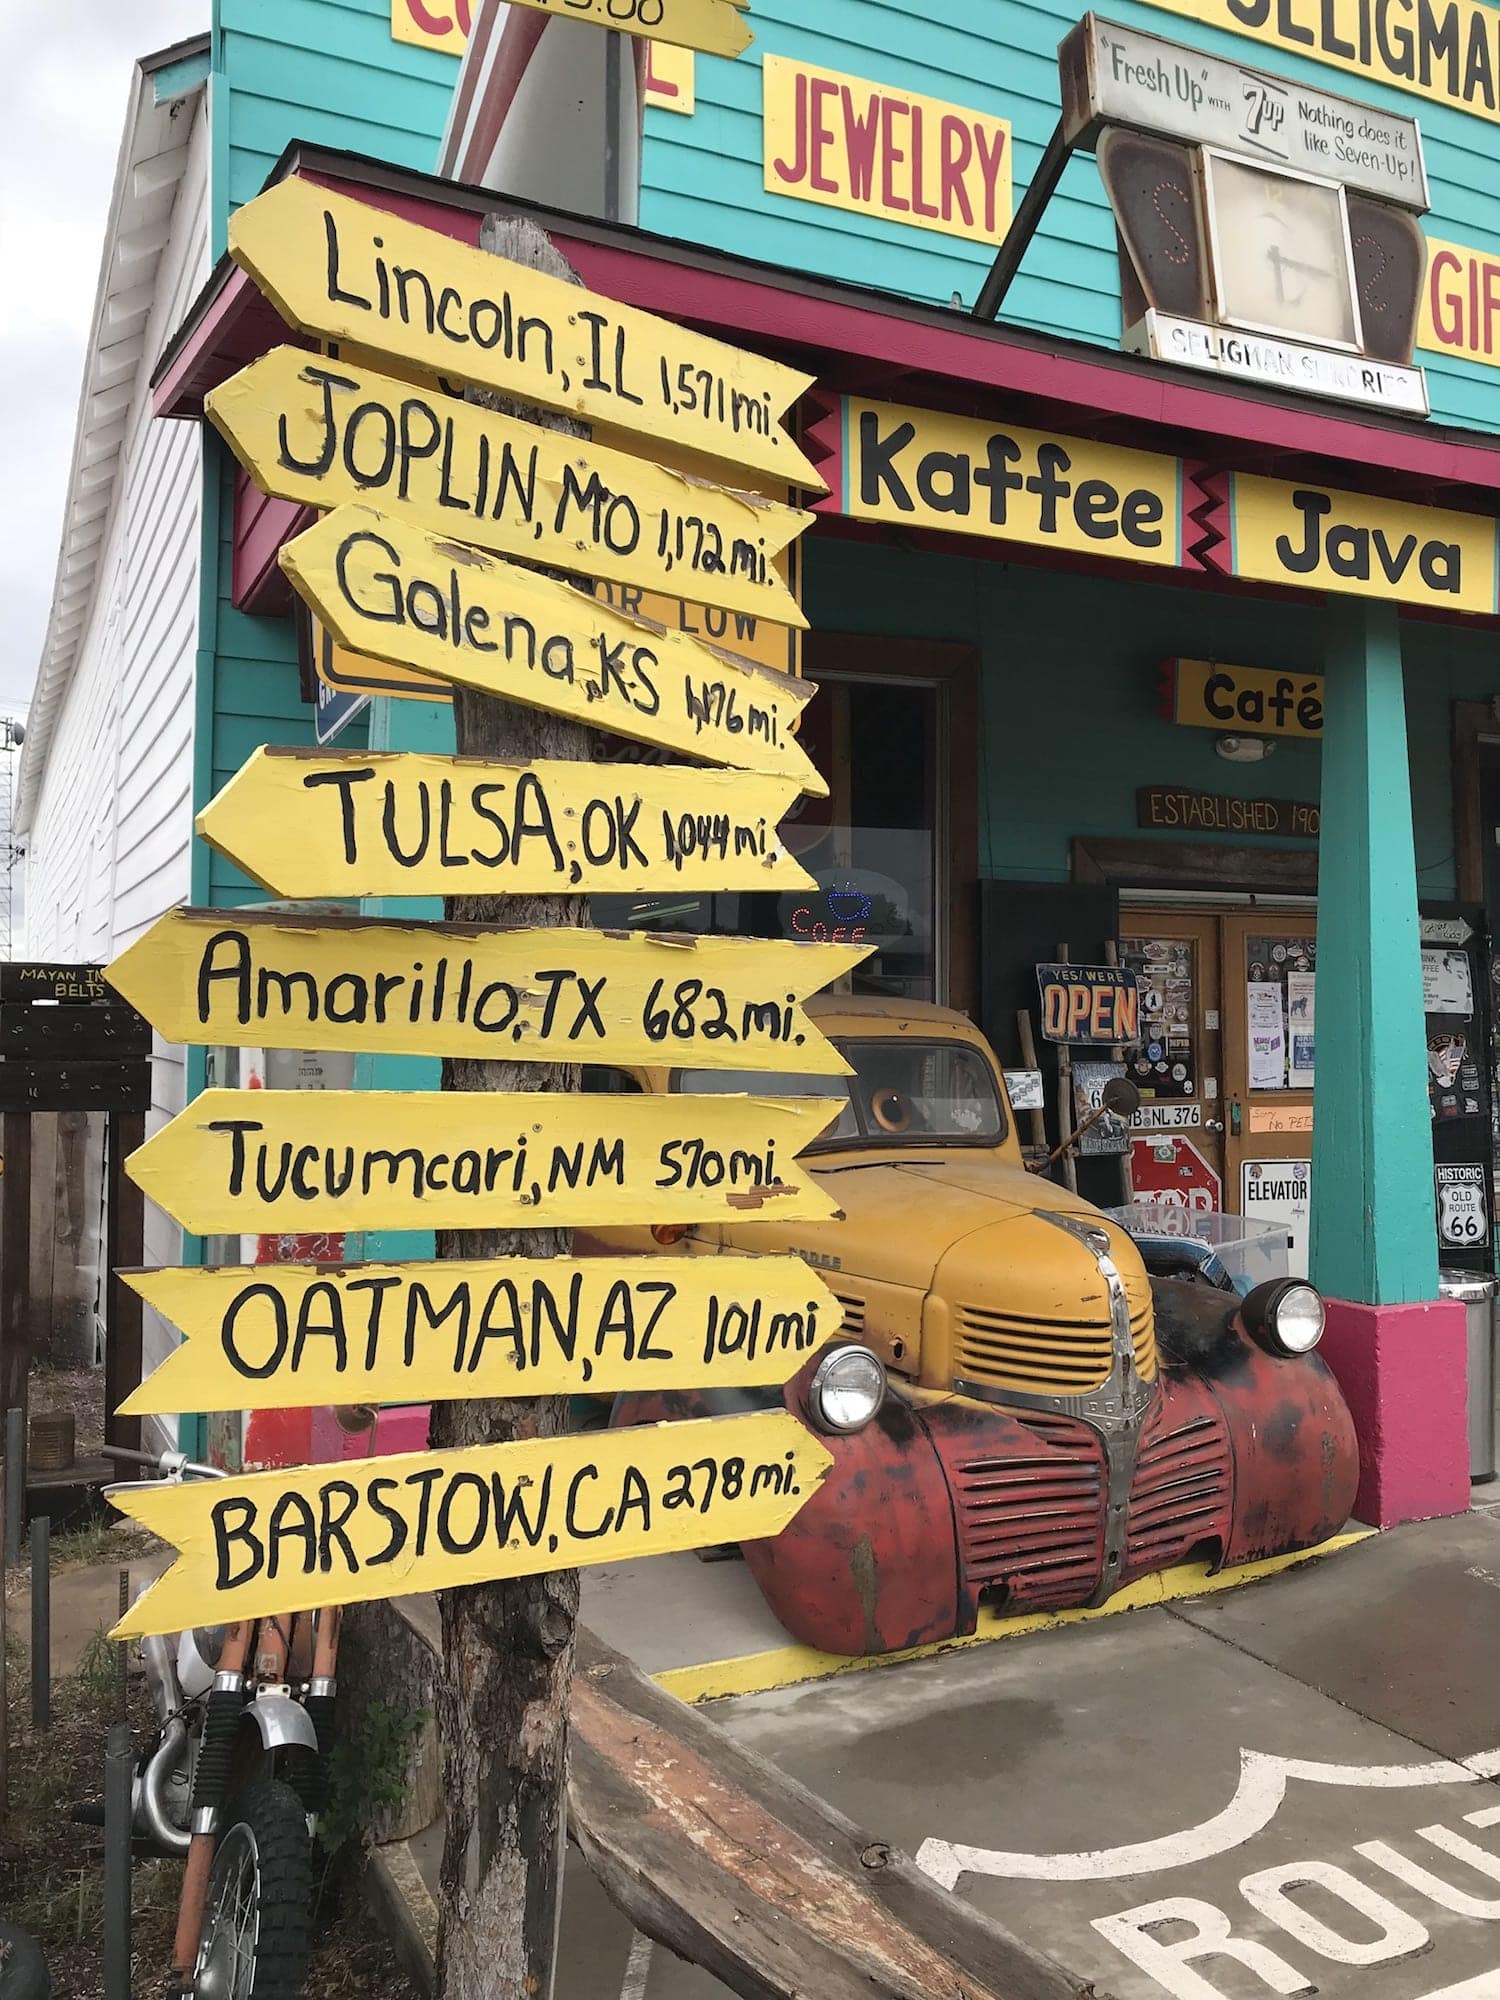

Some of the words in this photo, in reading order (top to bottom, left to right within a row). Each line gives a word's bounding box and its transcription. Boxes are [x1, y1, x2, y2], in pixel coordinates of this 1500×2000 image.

[1207, 96, 1232, 112] WITH
[1299, 100, 1354, 139] Nothing
[1358, 120, 1390, 146] does
[1394, 130, 1408, 151] it
[774, 73, 1006, 233] JEWELRY
[1303, 130, 1329, 155] like
[1335, 136, 1415, 183] Seven-Up!
[1430, 250, 1500, 354] GIF
[860, 410, 1164, 549] Kaffee
[554, 462, 642, 556] MO
[1275, 490, 1462, 594] Java
[1203, 673, 1323, 730] Café
[582, 795, 650, 871] OK
[1150, 794, 1279, 830] ESTABLISHED
[20, 968, 76, 982] MAYAN
[54, 983, 105, 998] BELTS
[535, 969, 609, 1041] TX
[1044, 983, 1137, 1039] OPEN
[1152, 1107, 1170, 1127] NL
[1174, 1106, 1199, 1125] 376
[1268, 1120, 1284, 1130] No
[548, 1139, 626, 1194] NM
[1248, 1180, 1308, 1201] ELEVATOR
[1437, 1166, 1482, 1180] HISTORIC
[1448, 1203, 1476, 1212] ROUTE
[1451, 1190, 1472, 1202] OLD
[1451, 1216, 1478, 1237] 66
[593, 1281, 679, 1362] AZ
[565, 1471, 652, 1540] CA
